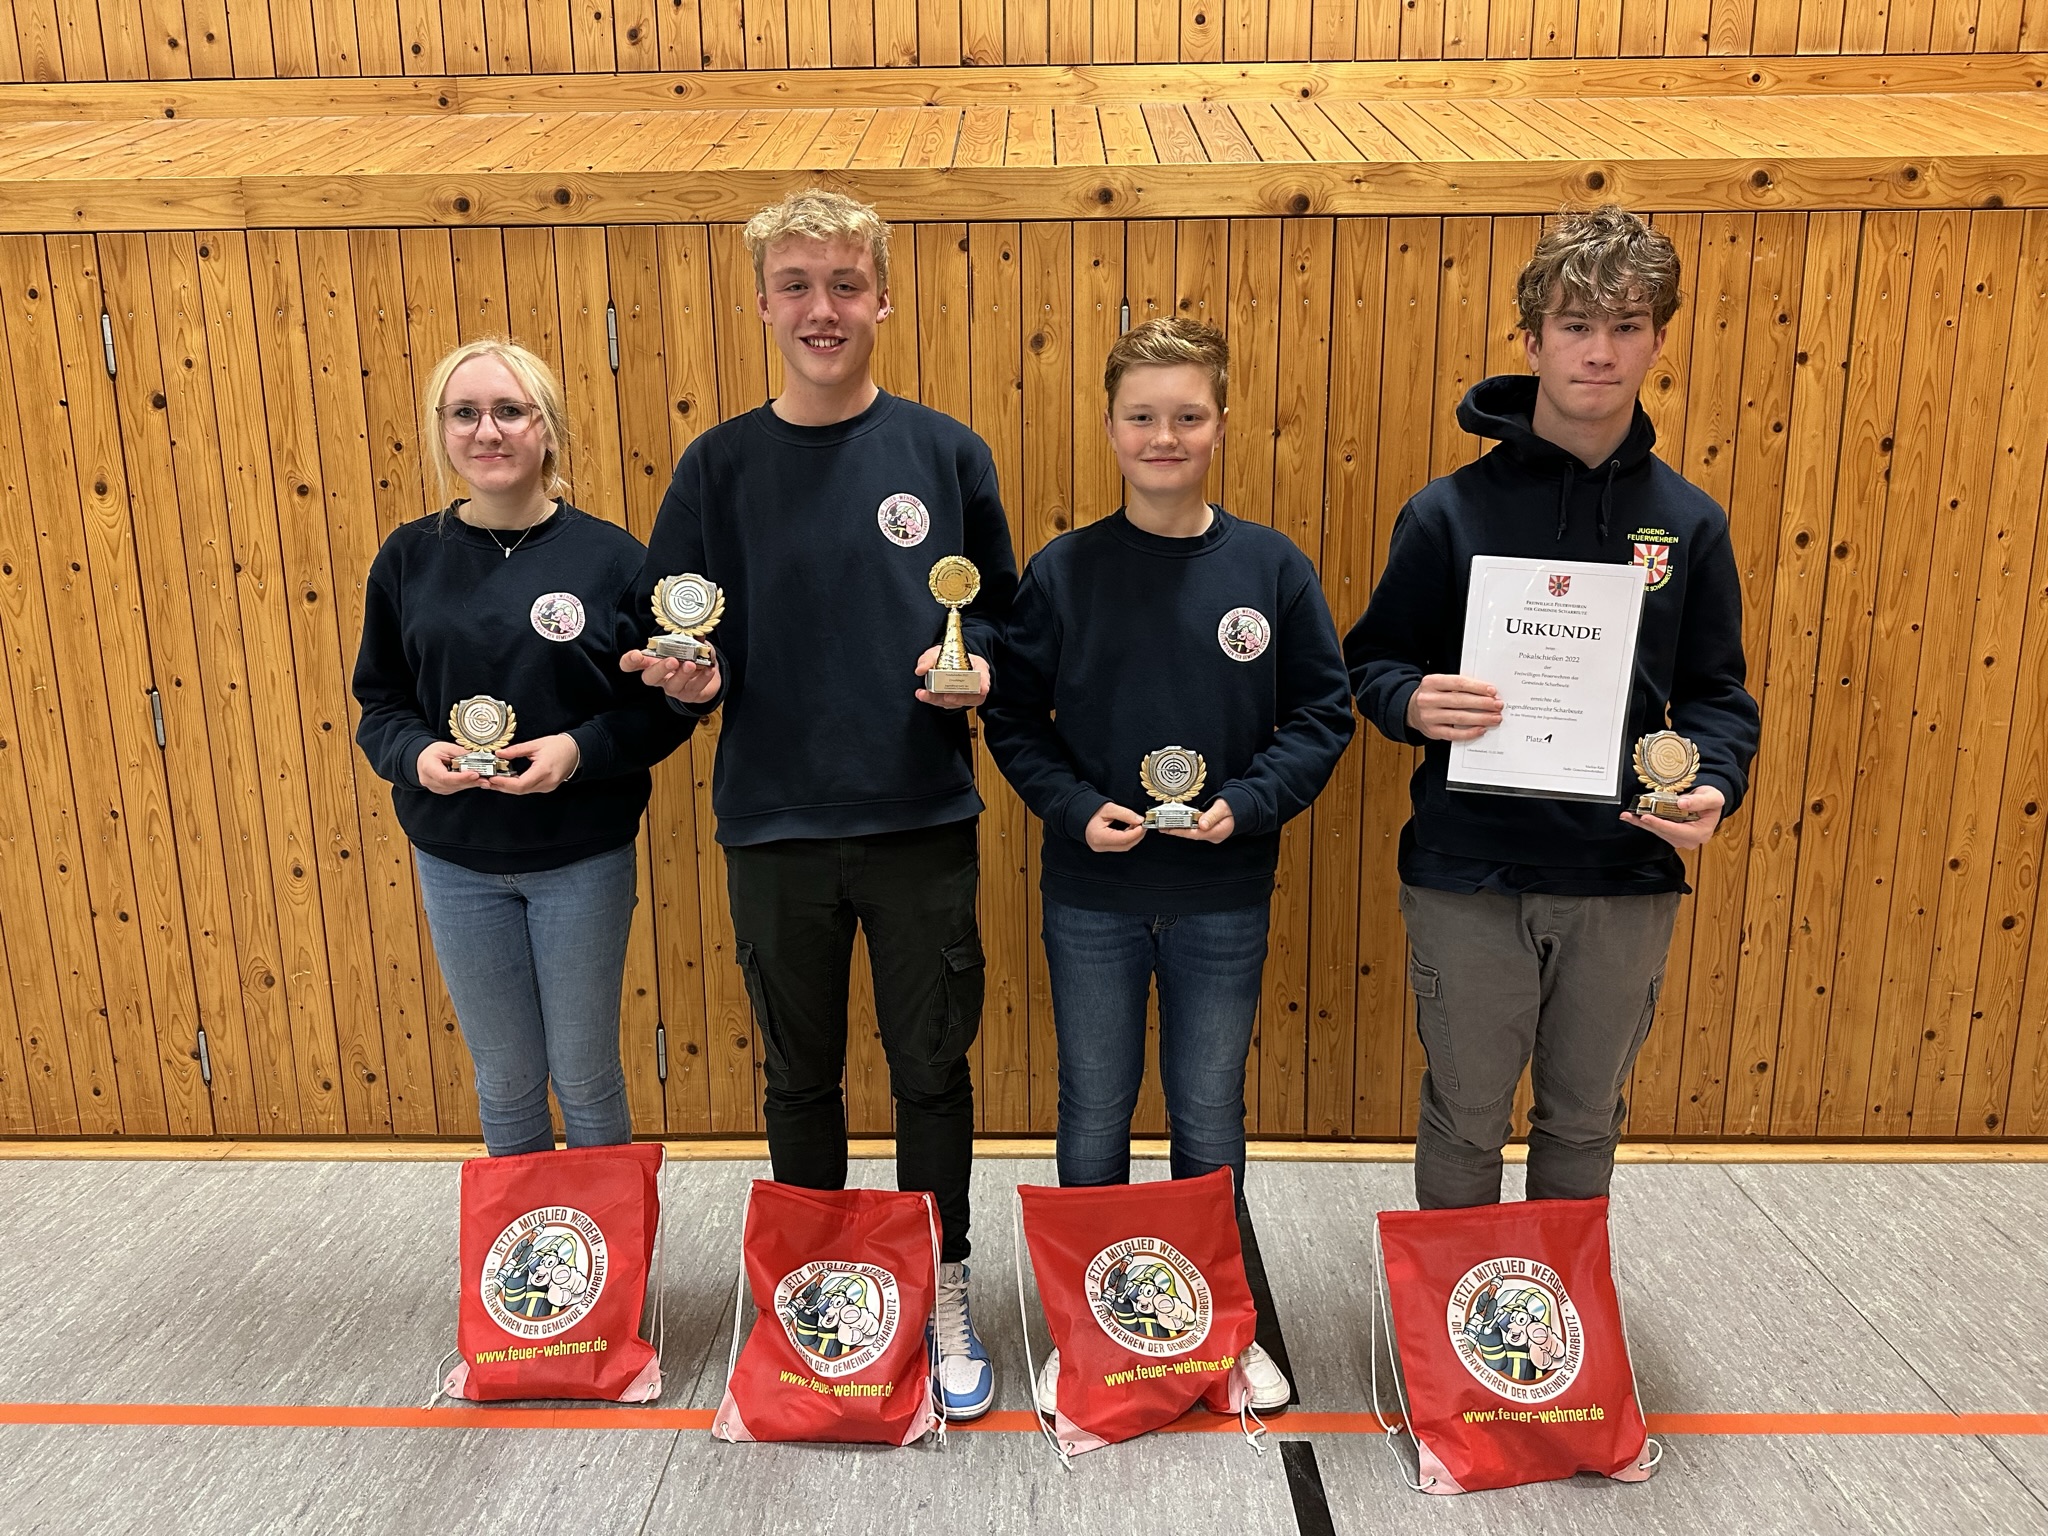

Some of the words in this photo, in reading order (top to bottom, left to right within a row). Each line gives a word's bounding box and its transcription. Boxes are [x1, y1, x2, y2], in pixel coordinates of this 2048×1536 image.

[1627, 534, 1679, 543] FEUERWEHREN
[1650, 565, 1673, 591] SCHARBEUTZ
[1506, 618, 1602, 640] URKUNDE
[1518, 652, 1564, 661] Pokalschießen
[1506, 703, 1552, 712] Jugendfeuerwehr
[1525, 735, 1543, 743] Platz
[1543, 733, 1553, 743] 1
[492, 1226, 519, 1258] JETZT
[518, 1209, 567, 1231] MITGLIED
[571, 1211, 603, 1247] WERDEN!
[485, 1268, 496, 1281] DIE
[1088, 1255, 1108, 1284] JETZT
[1105, 1239, 1154, 1261] MITGLIED
[1159, 1241, 1200, 1282] WERDEN!
[581, 1254, 605, 1309] SCHARBEUTZ
[783, 1272, 806, 1291] JETZT
[807, 1262, 857, 1276] MITGLIED
[1452, 1277, 1476, 1311] JETZT
[1473, 1260, 1525, 1283] MITGLIED
[1531, 1263, 1569, 1306] WERDEN!
[484, 1283, 522, 1332] FEUERWEHREN
[1089, 1291, 1101, 1303] DIE
[542, 1308, 583, 1334] GEMEINDE
[1196, 1286, 1209, 1335] SCHARBEUTZ
[523, 1323, 539, 1335] DER
[777, 1295, 787, 1309] DIE
[814, 1361, 830, 1372] DER
[833, 1349, 875, 1374] GEMEINDE
[872, 1299, 896, 1351] SCHARBEUTZ
[1093, 1304, 1145, 1350] FEUERWEHREN
[1452, 1321, 1462, 1336] DIE
[476, 1336, 607, 1364] www.feuer-wehrner.de
[1148, 1343, 1165, 1353] DER
[1167, 1334, 1201, 1351] GEMEINDE
[1564, 1314, 1581, 1374] SCHARBEUTZ
[1104, 1355, 1235, 1387] www.feuer-wehrner.de
[1455, 1339, 1509, 1394] FEUERWEHREN
[1511, 1387, 1528, 1400] DER
[1530, 1372, 1570, 1399] GEMEINDE
[1463, 1404, 1605, 1424] www.feuer-wehrner.de
